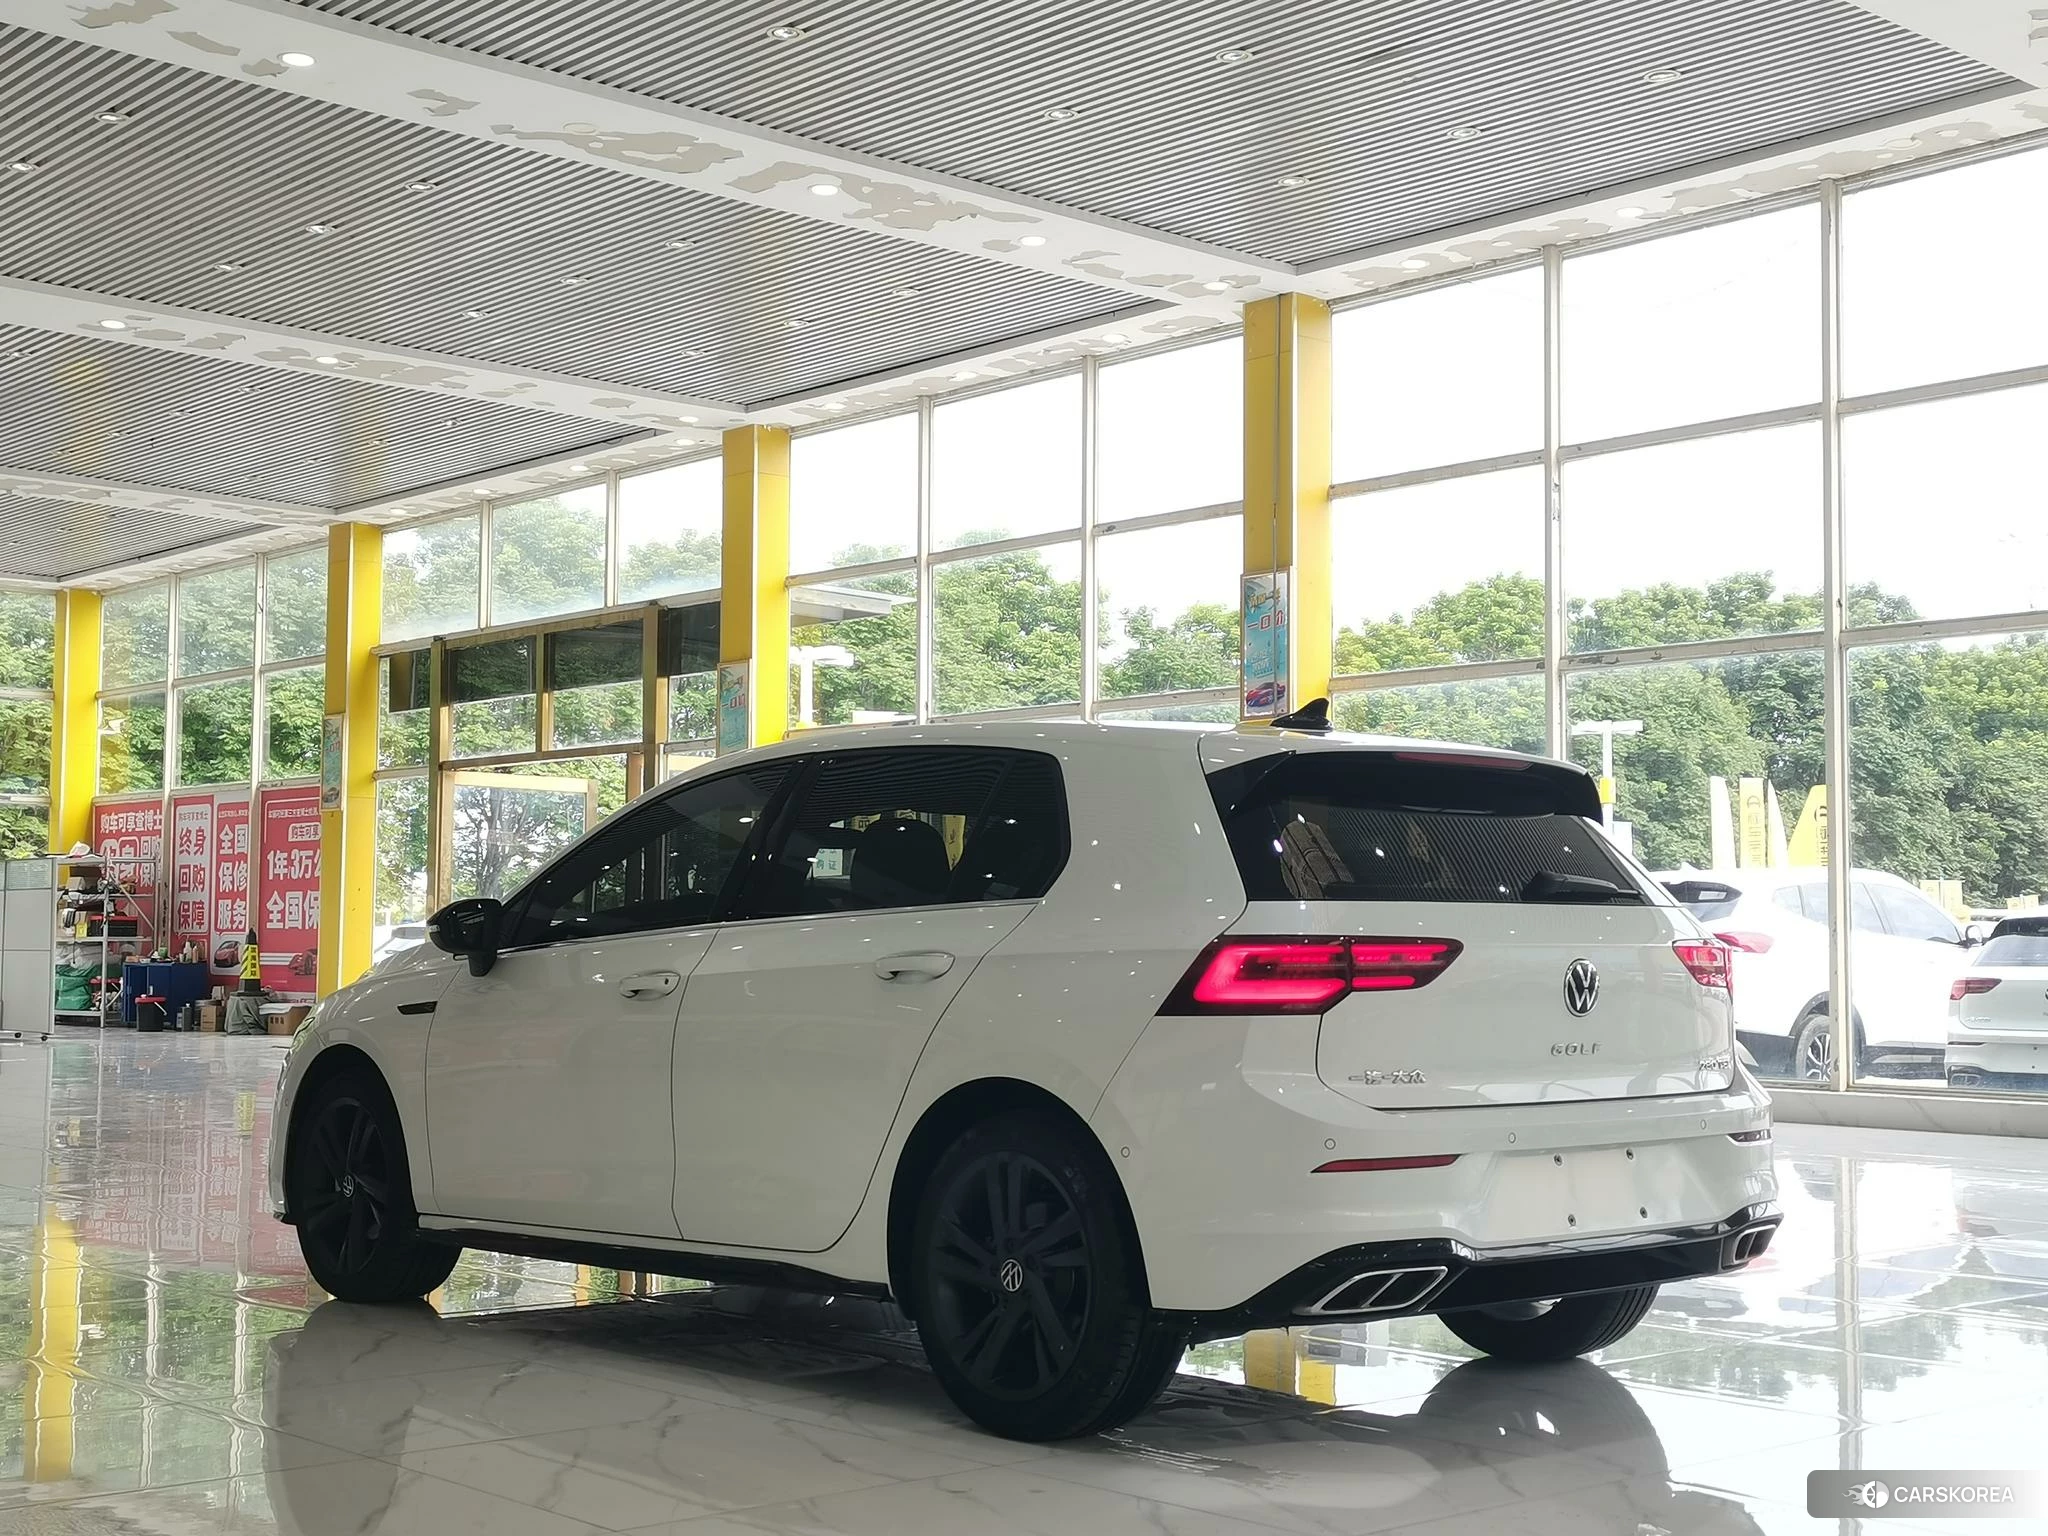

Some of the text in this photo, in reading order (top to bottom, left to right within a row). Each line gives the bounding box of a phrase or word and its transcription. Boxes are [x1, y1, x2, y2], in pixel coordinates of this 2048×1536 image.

[100, 808, 163, 834] 购车可享查博士
[178, 825, 206, 856] 终身
[219, 823, 249, 855] 全国
[178, 863, 206, 893] 回购
[218, 860, 247, 892] 保修
[177, 900, 205, 930] 保障
[216, 898, 247, 930] 服务
[1549, 1042, 1602, 1057] GOLF
